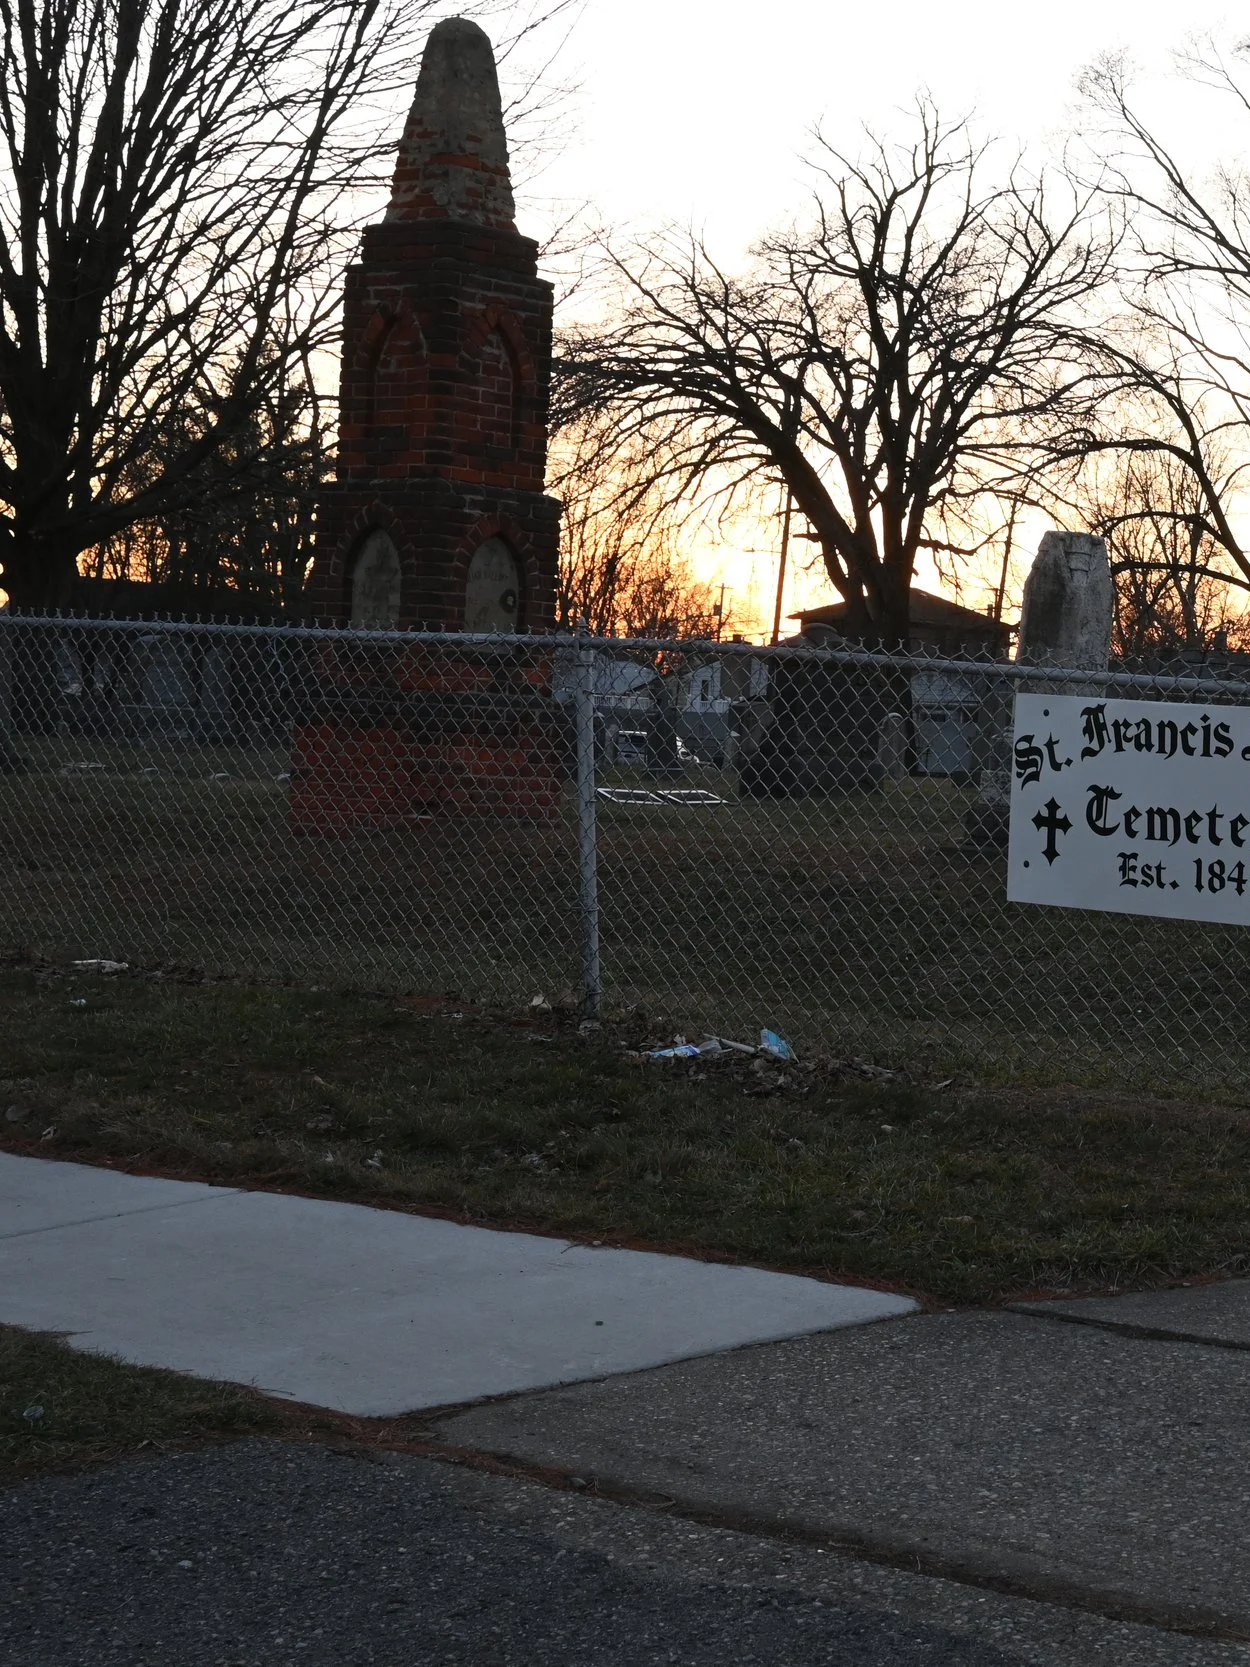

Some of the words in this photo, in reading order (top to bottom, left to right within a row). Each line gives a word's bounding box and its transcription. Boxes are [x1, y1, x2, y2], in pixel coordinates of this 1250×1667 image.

[1014, 733, 1073, 790] St.
[1080, 703, 1235, 760] Francis
[1117, 852, 1179, 890] Est.
